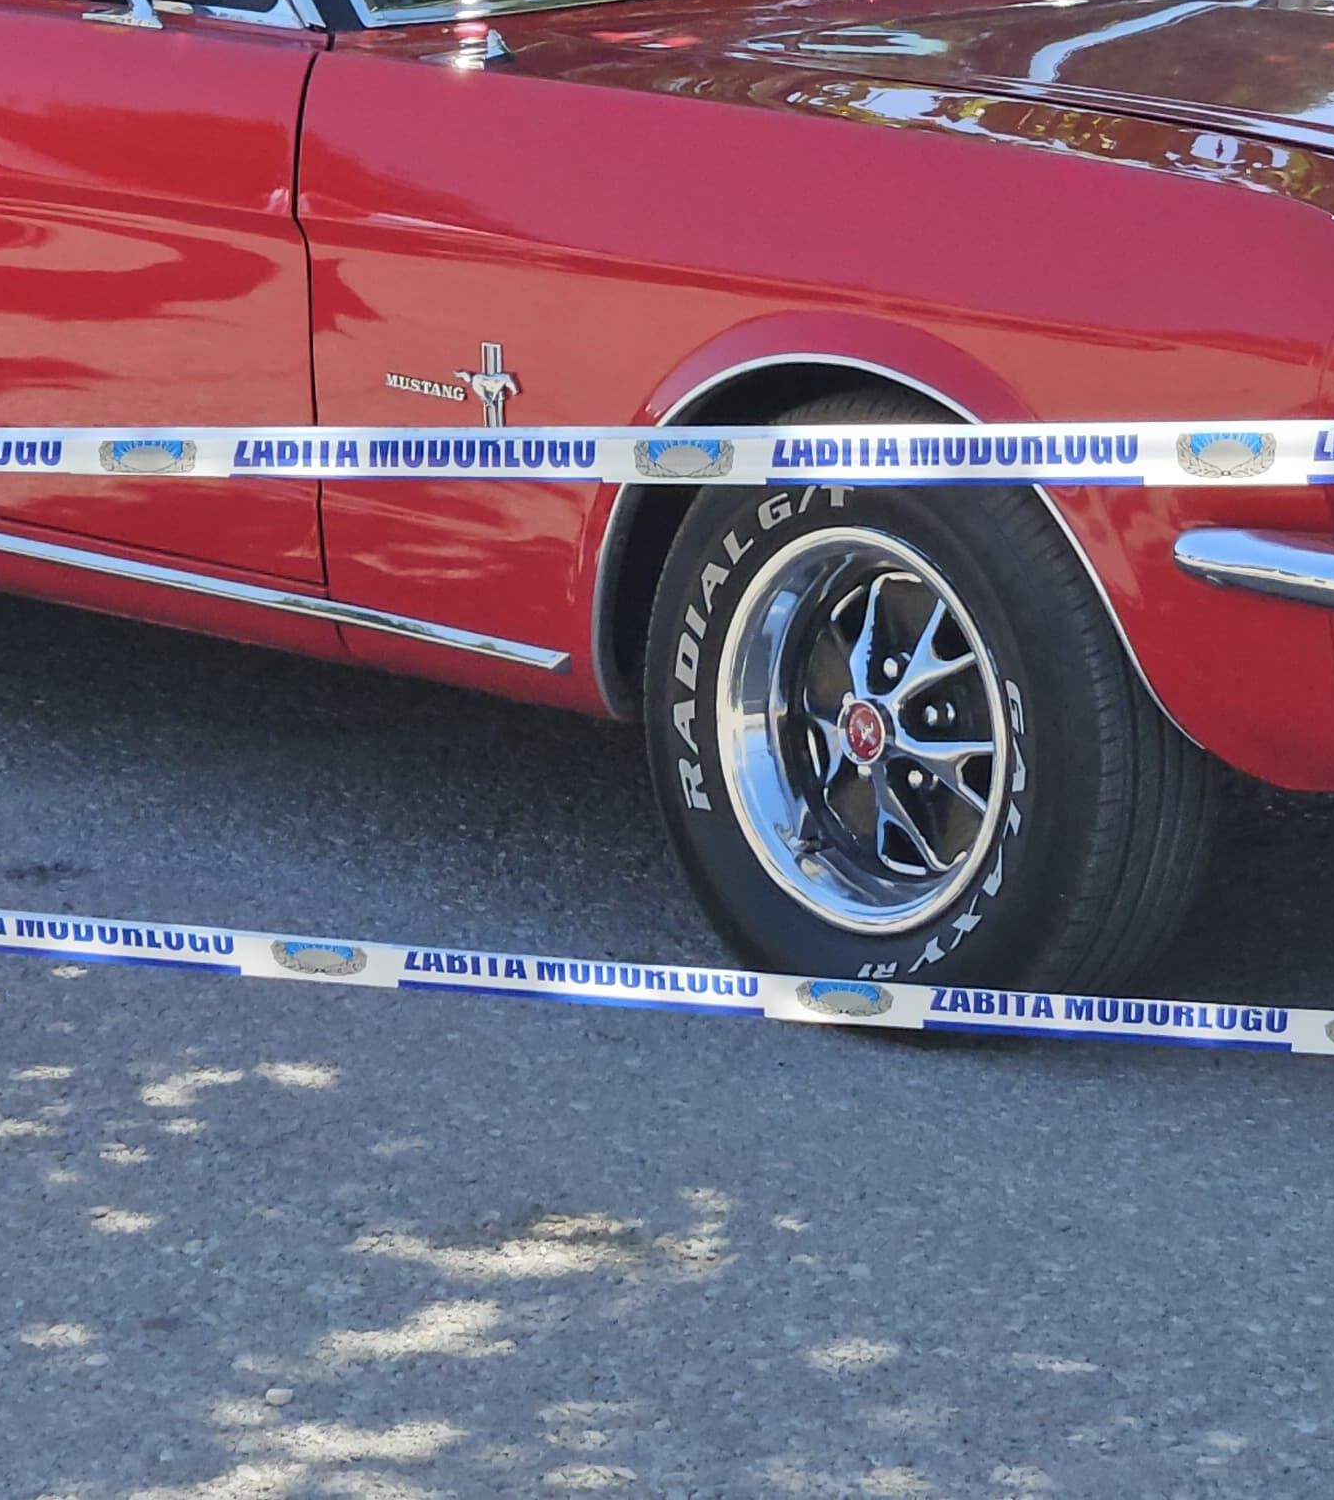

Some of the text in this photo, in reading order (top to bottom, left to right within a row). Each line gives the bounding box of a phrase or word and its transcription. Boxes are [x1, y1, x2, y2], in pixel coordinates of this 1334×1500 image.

[385, 372, 466, 401] MUSTANG
[673, 533, 755, 812] RADIAL
[930, 988, 1054, 1019] ZABITA
